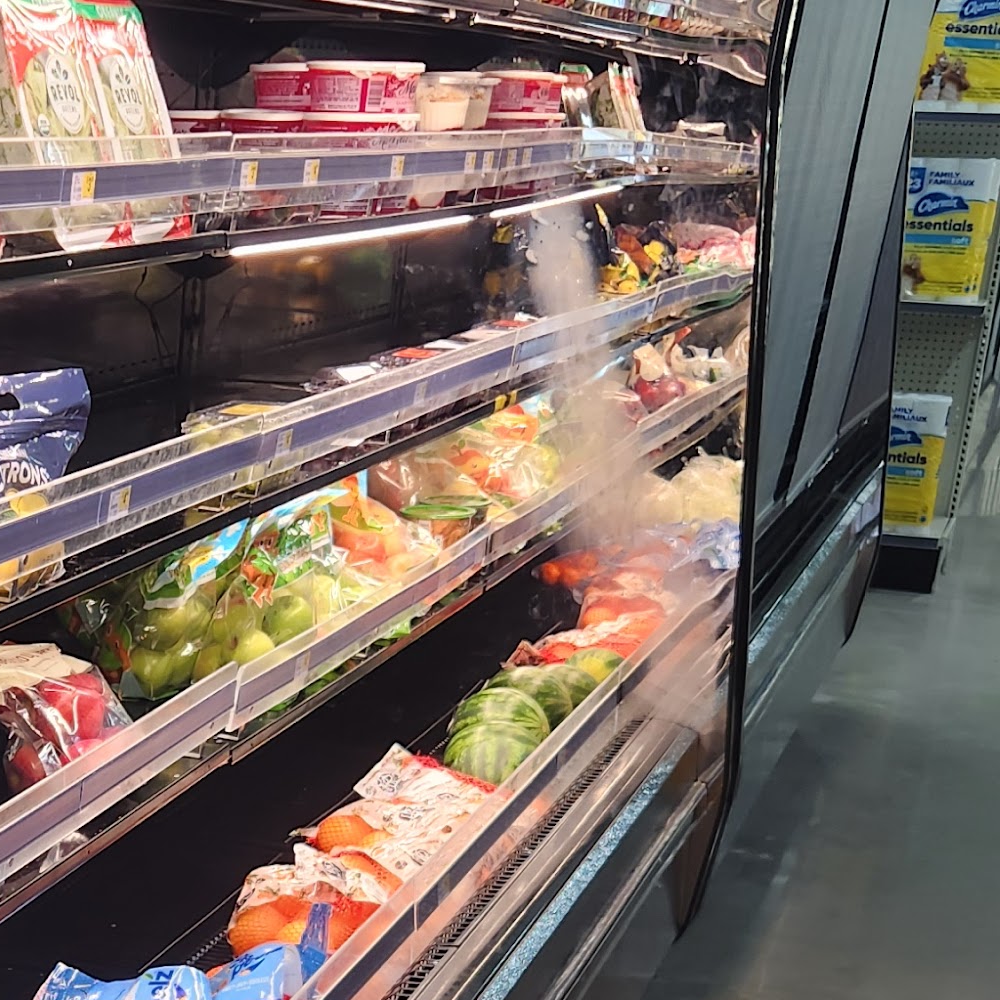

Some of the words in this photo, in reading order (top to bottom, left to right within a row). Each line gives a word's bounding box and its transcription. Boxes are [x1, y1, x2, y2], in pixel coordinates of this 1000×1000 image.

[945, 22, 1000, 36] essenti
[50, 84, 81, 103] REVOL
[114, 87, 142, 105] REVOL
[929, 179, 975, 187] FAMILIAUX
[906, 219, 974, 233] ssentials
[893, 407, 914, 415] MILY
[893, 414, 928, 423] MILIAUX
